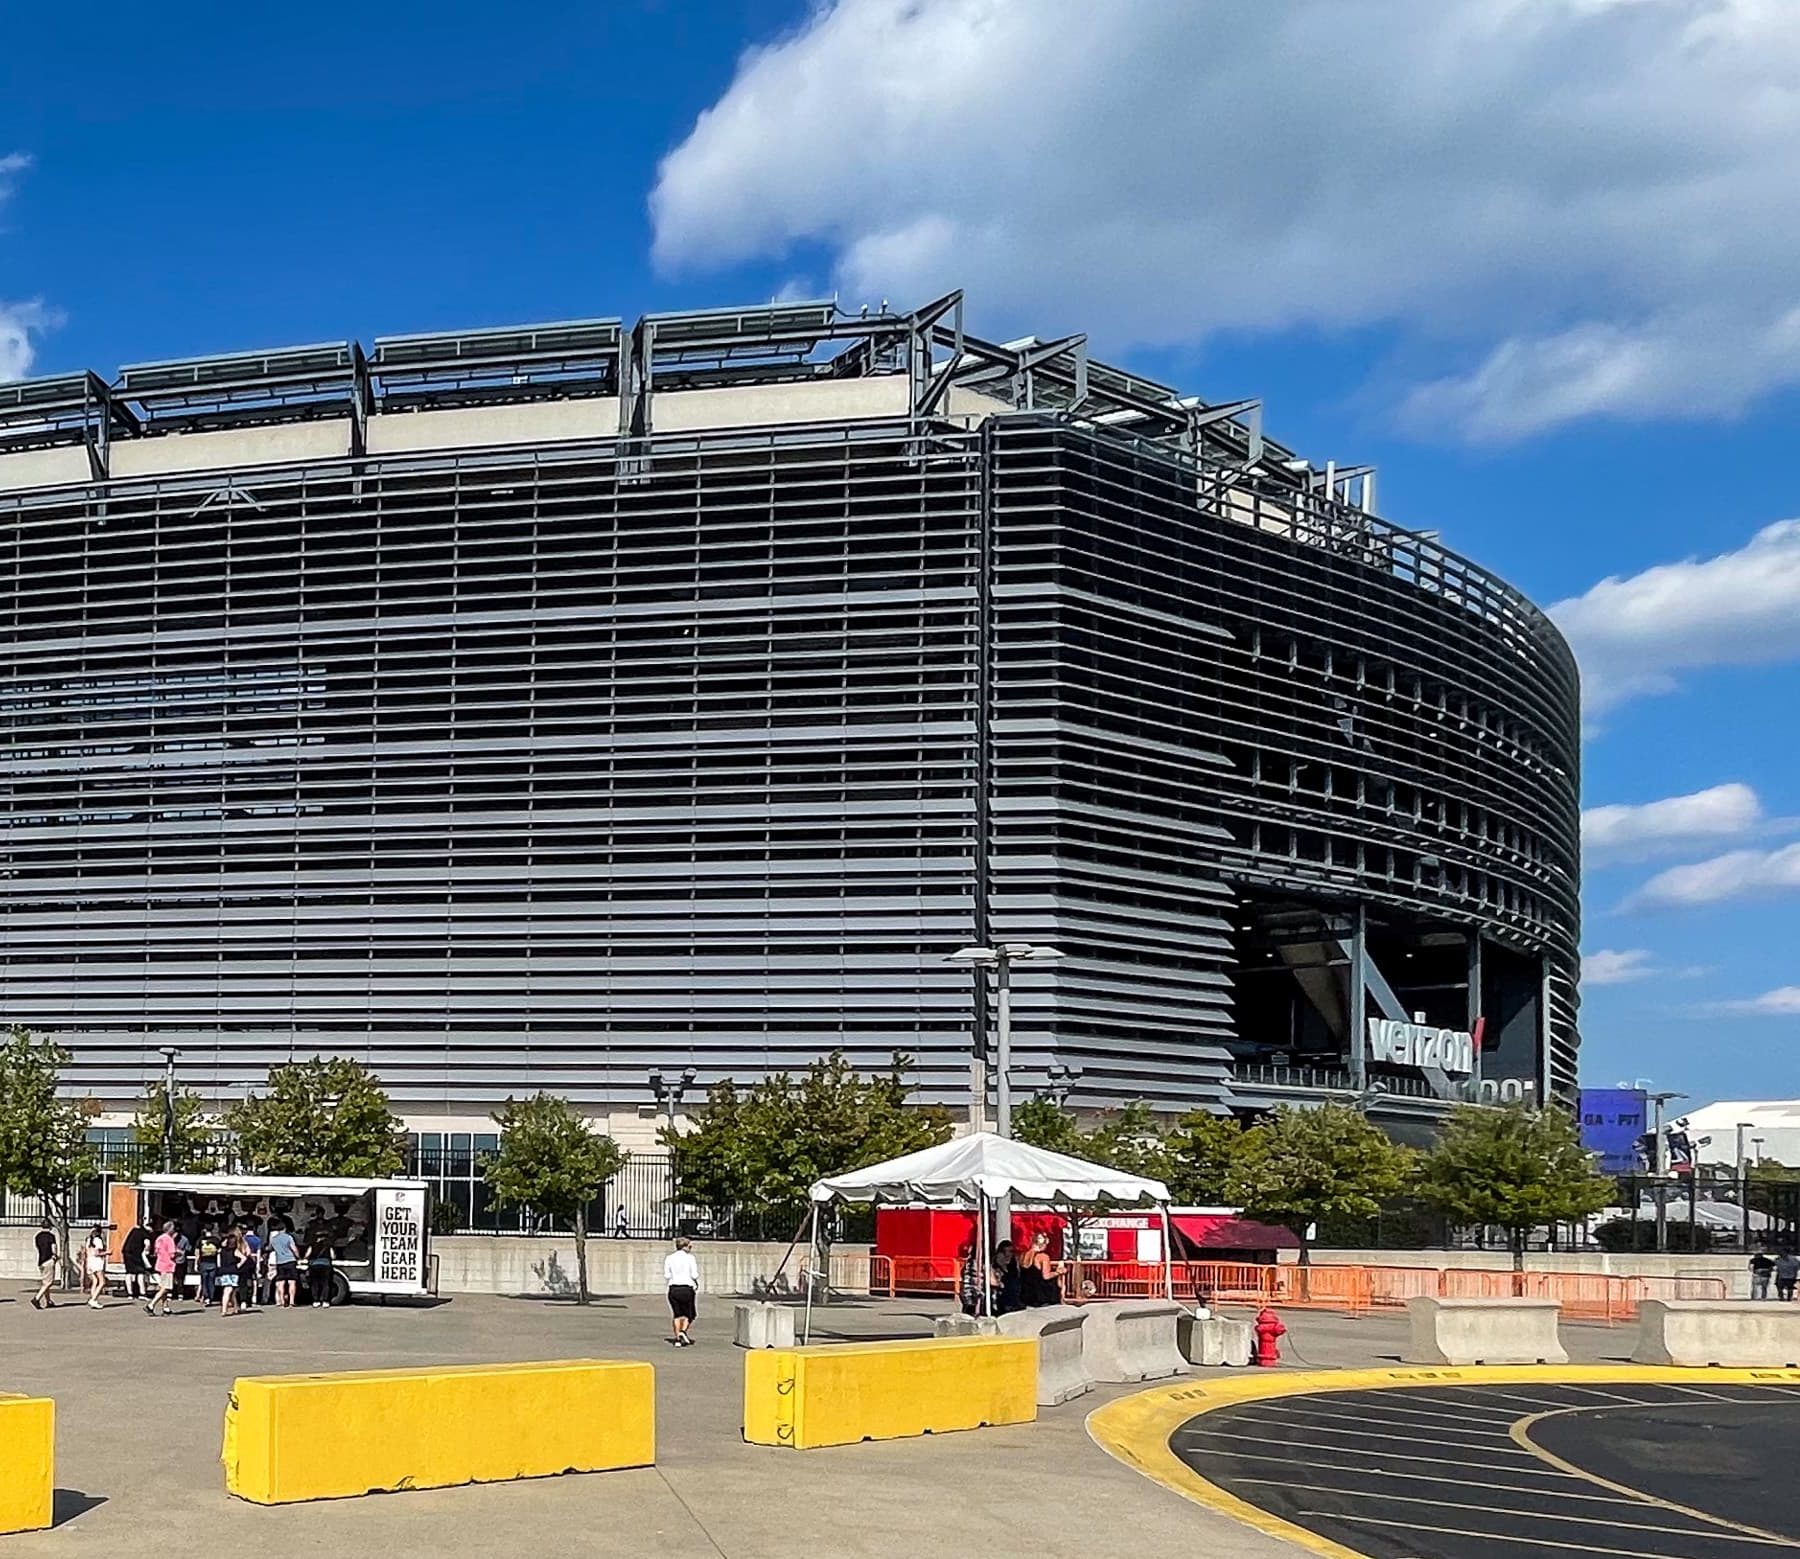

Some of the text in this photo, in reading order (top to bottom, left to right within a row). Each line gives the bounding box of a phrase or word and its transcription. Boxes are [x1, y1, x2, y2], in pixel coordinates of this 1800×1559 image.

[1368, 1011, 1473, 1074] verizon
[385, 1206, 412, 1221] GET
[382, 1222, 417, 1235] YOUR
[381, 1236, 418, 1250] TEAM
[382, 1251, 417, 1265] GEAR
[381, 1266, 417, 1280] HERE
